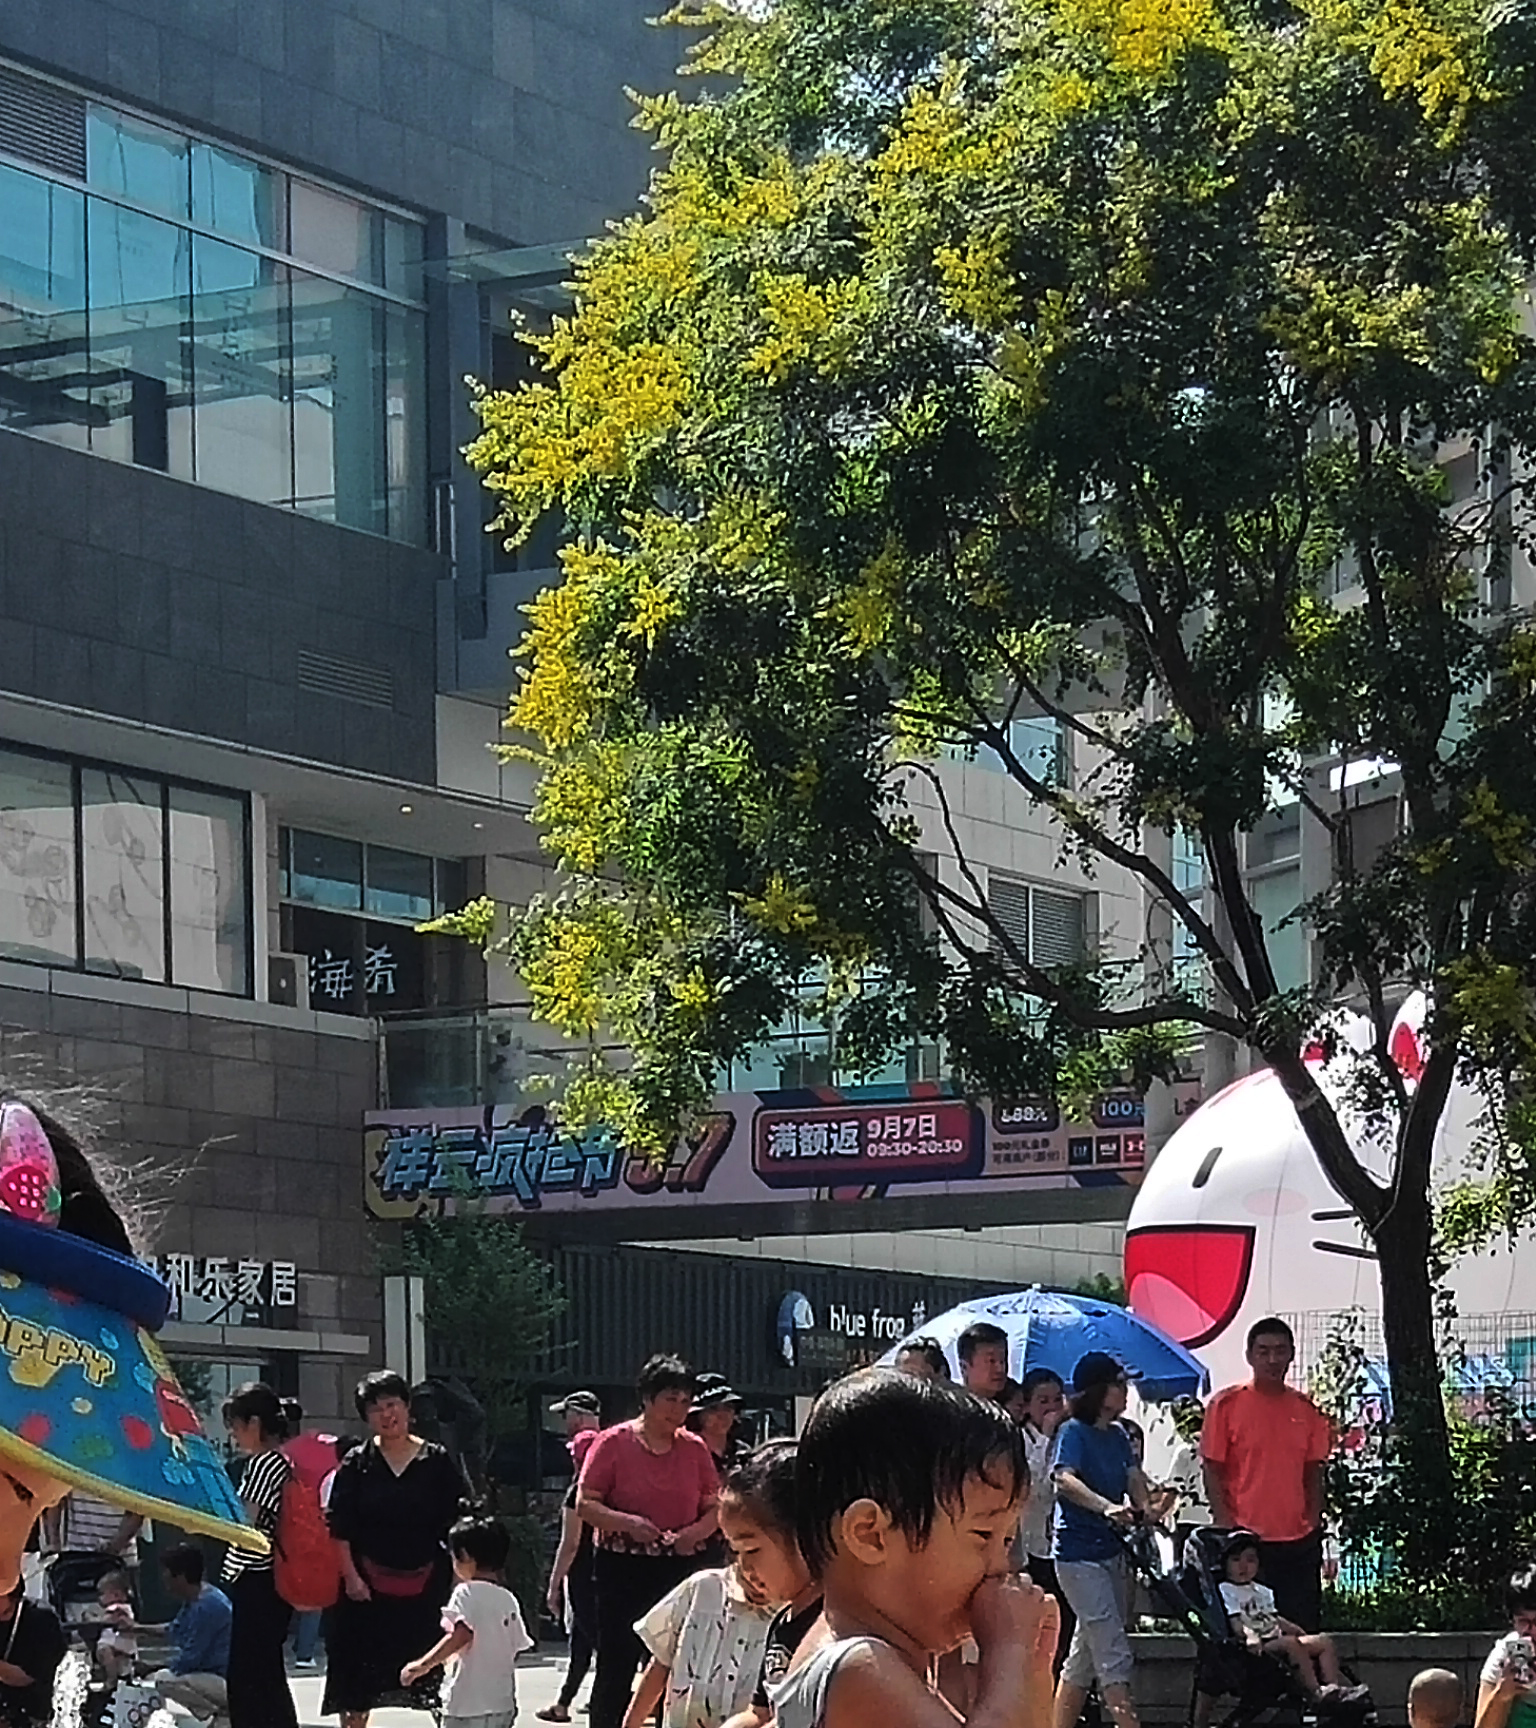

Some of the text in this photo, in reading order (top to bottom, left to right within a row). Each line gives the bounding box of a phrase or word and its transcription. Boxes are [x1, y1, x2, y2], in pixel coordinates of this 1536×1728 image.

[767, 1120, 860, 1158] 满额返
[866, 1113, 937, 1140] 9月7日
[866, 1138, 963, 1158] 09:30-20:30
[829, 1303, 866, 1337] blue
